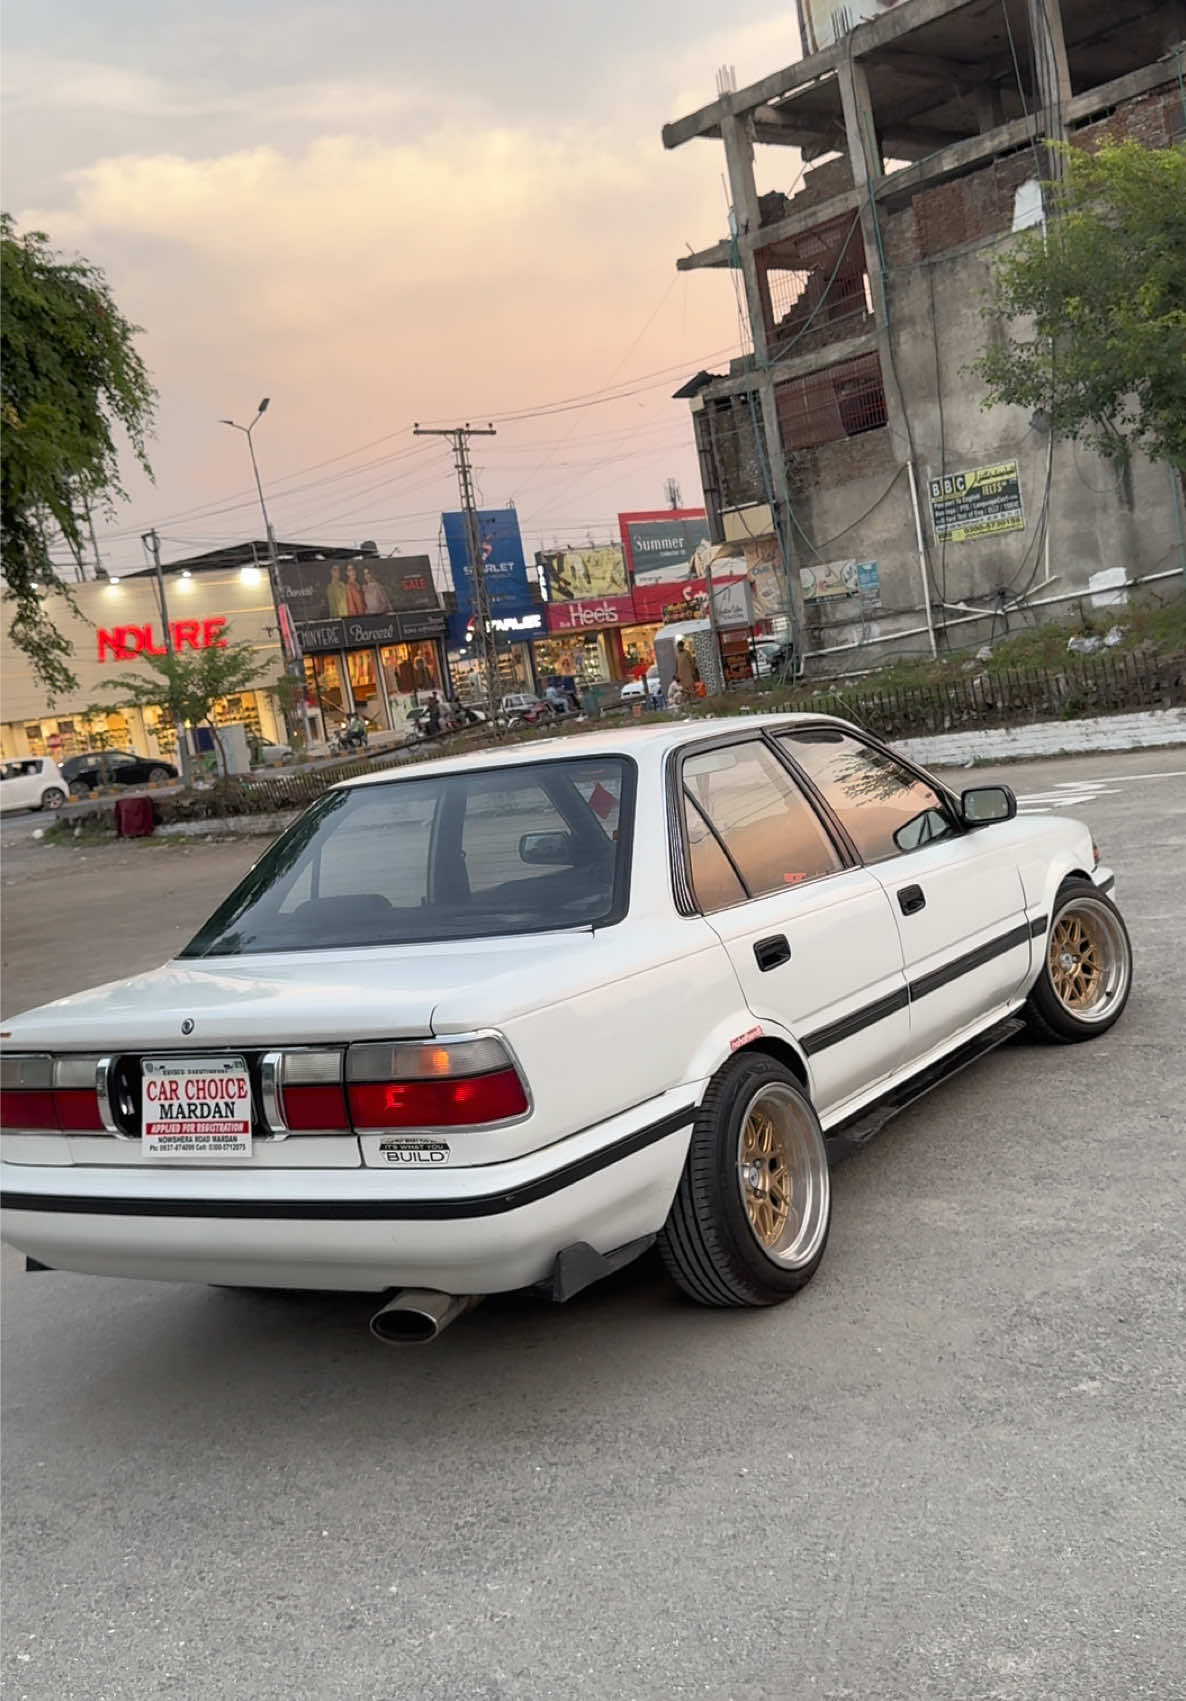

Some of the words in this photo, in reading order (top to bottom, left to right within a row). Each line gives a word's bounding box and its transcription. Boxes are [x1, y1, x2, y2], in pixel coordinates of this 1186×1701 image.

[569, 600, 618, 626] Heels
[147, 1080, 180, 1101] CAR
[185, 1078, 248, 1100] CHOICE
[159, 1101, 236, 1120] MARDAN
[151, 1123, 180, 1134] APPLIED
[181, 1123, 196, 1134] FOR
[197, 1122, 244, 1133] REGISTRATION
[212, 1135, 238, 1143] MARDAN
[386, 1151, 445, 1162] BUILD
